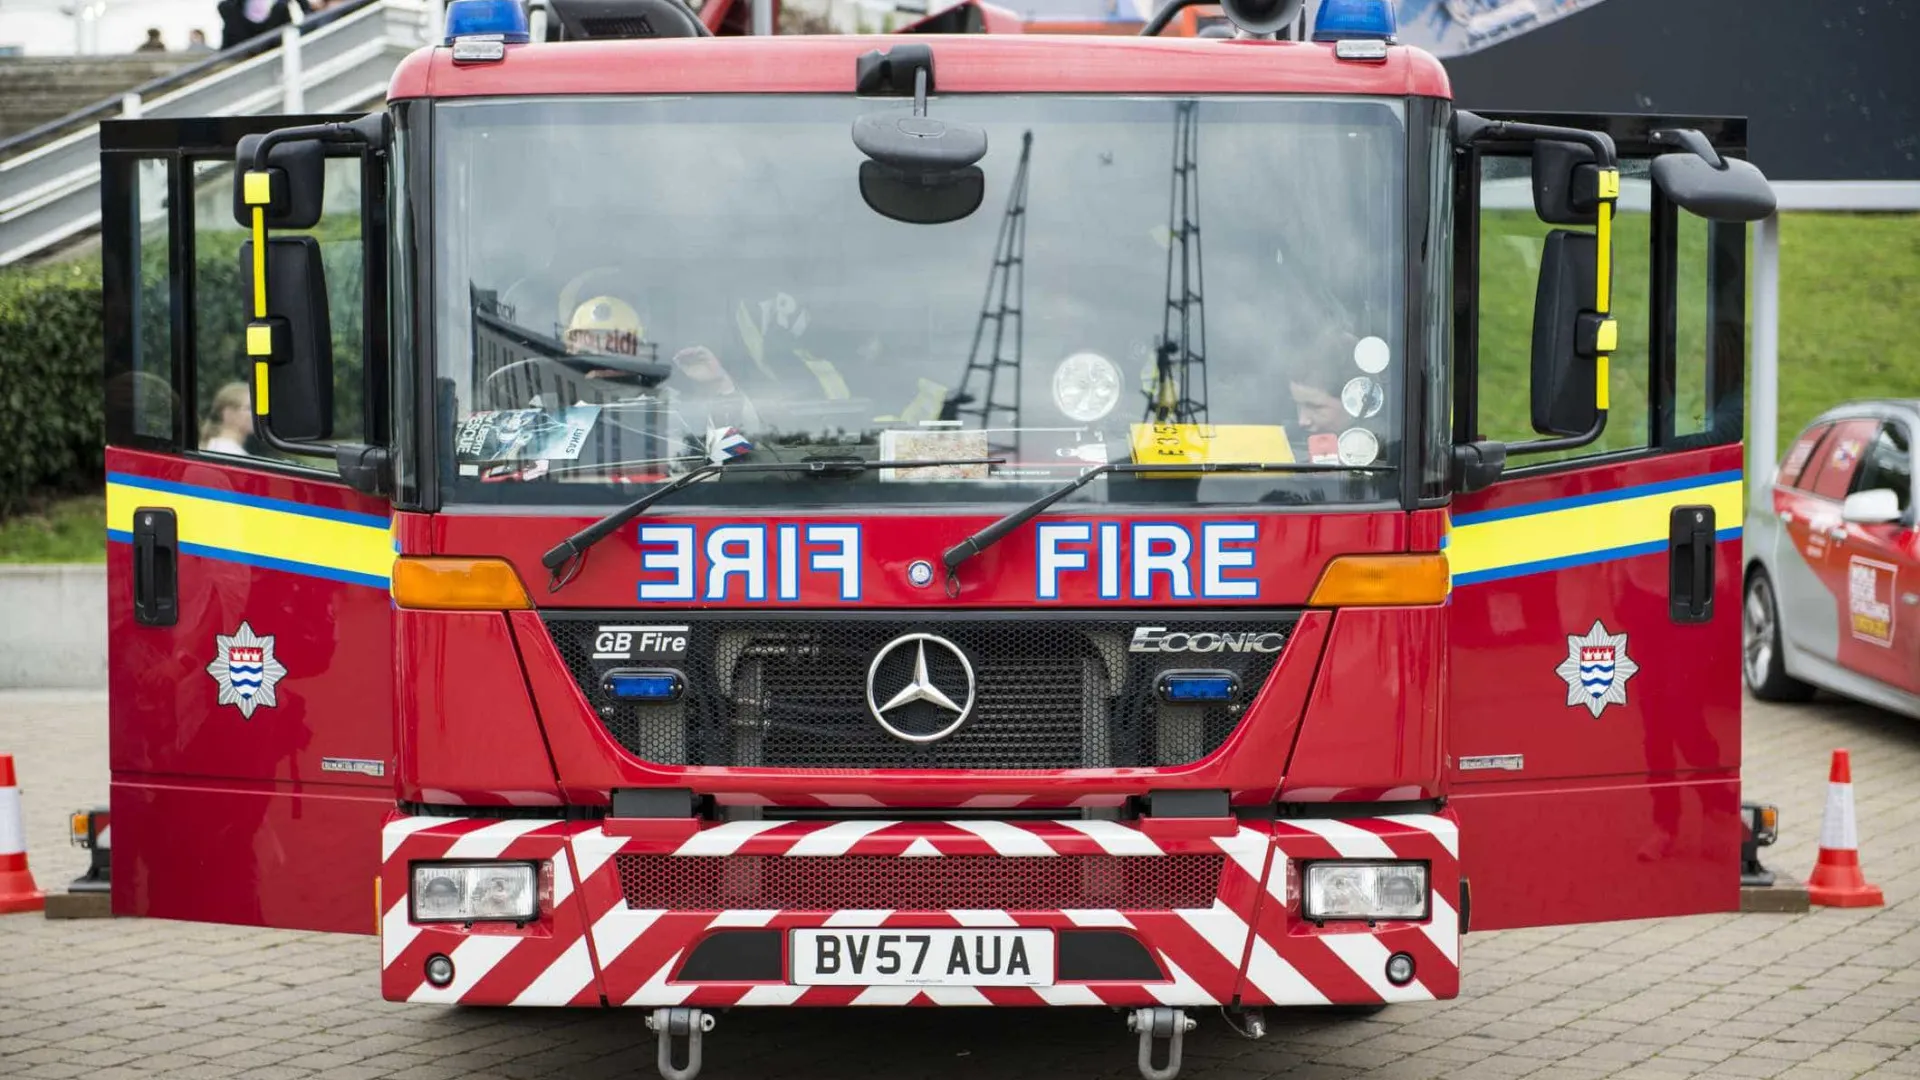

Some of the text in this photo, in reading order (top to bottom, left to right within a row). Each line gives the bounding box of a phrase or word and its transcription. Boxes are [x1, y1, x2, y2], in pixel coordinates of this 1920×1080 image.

[1037, 524, 1260, 598] FIRE
[595, 632, 686, 652] GB Fire
[815, 934, 1031, 975] BV57 AUA
